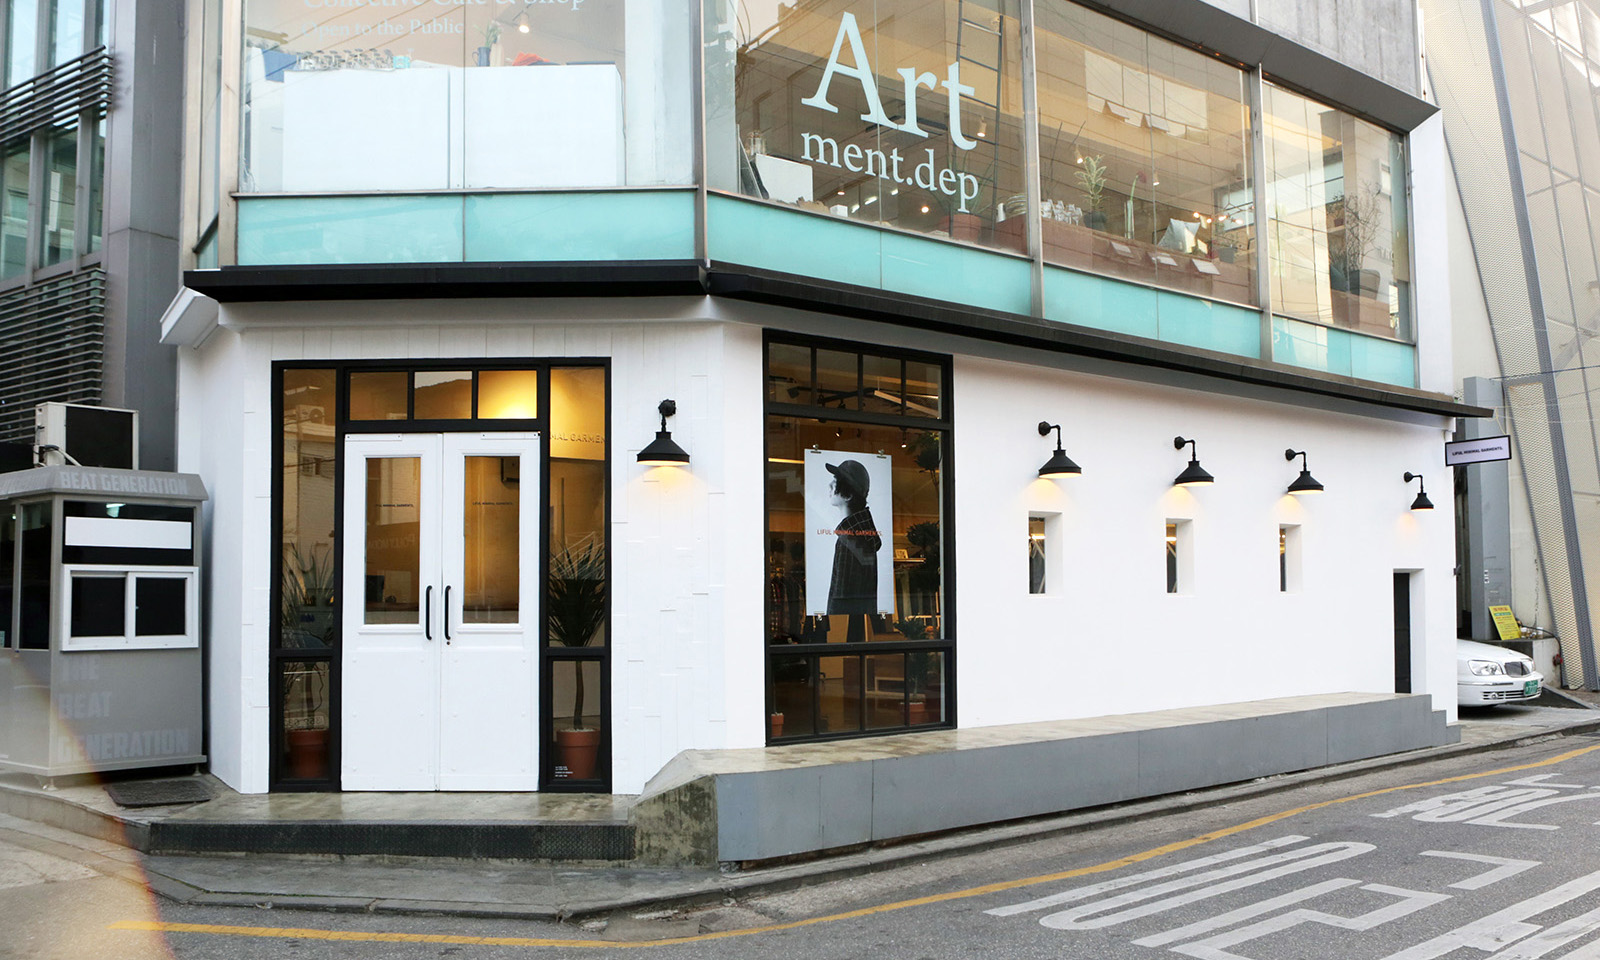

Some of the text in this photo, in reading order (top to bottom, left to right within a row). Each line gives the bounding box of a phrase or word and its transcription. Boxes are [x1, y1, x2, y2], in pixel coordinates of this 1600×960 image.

[301, 17, 463, 41] Open to the Public
[801, 11, 977, 151] Art
[800, 132, 979, 213] ment.dep
[60, 471, 98, 490] BEAT
[101, 473, 188, 496] GENERATION
[58, 691, 111, 719] BEAT
[57, 728, 189, 763] GENERATION
